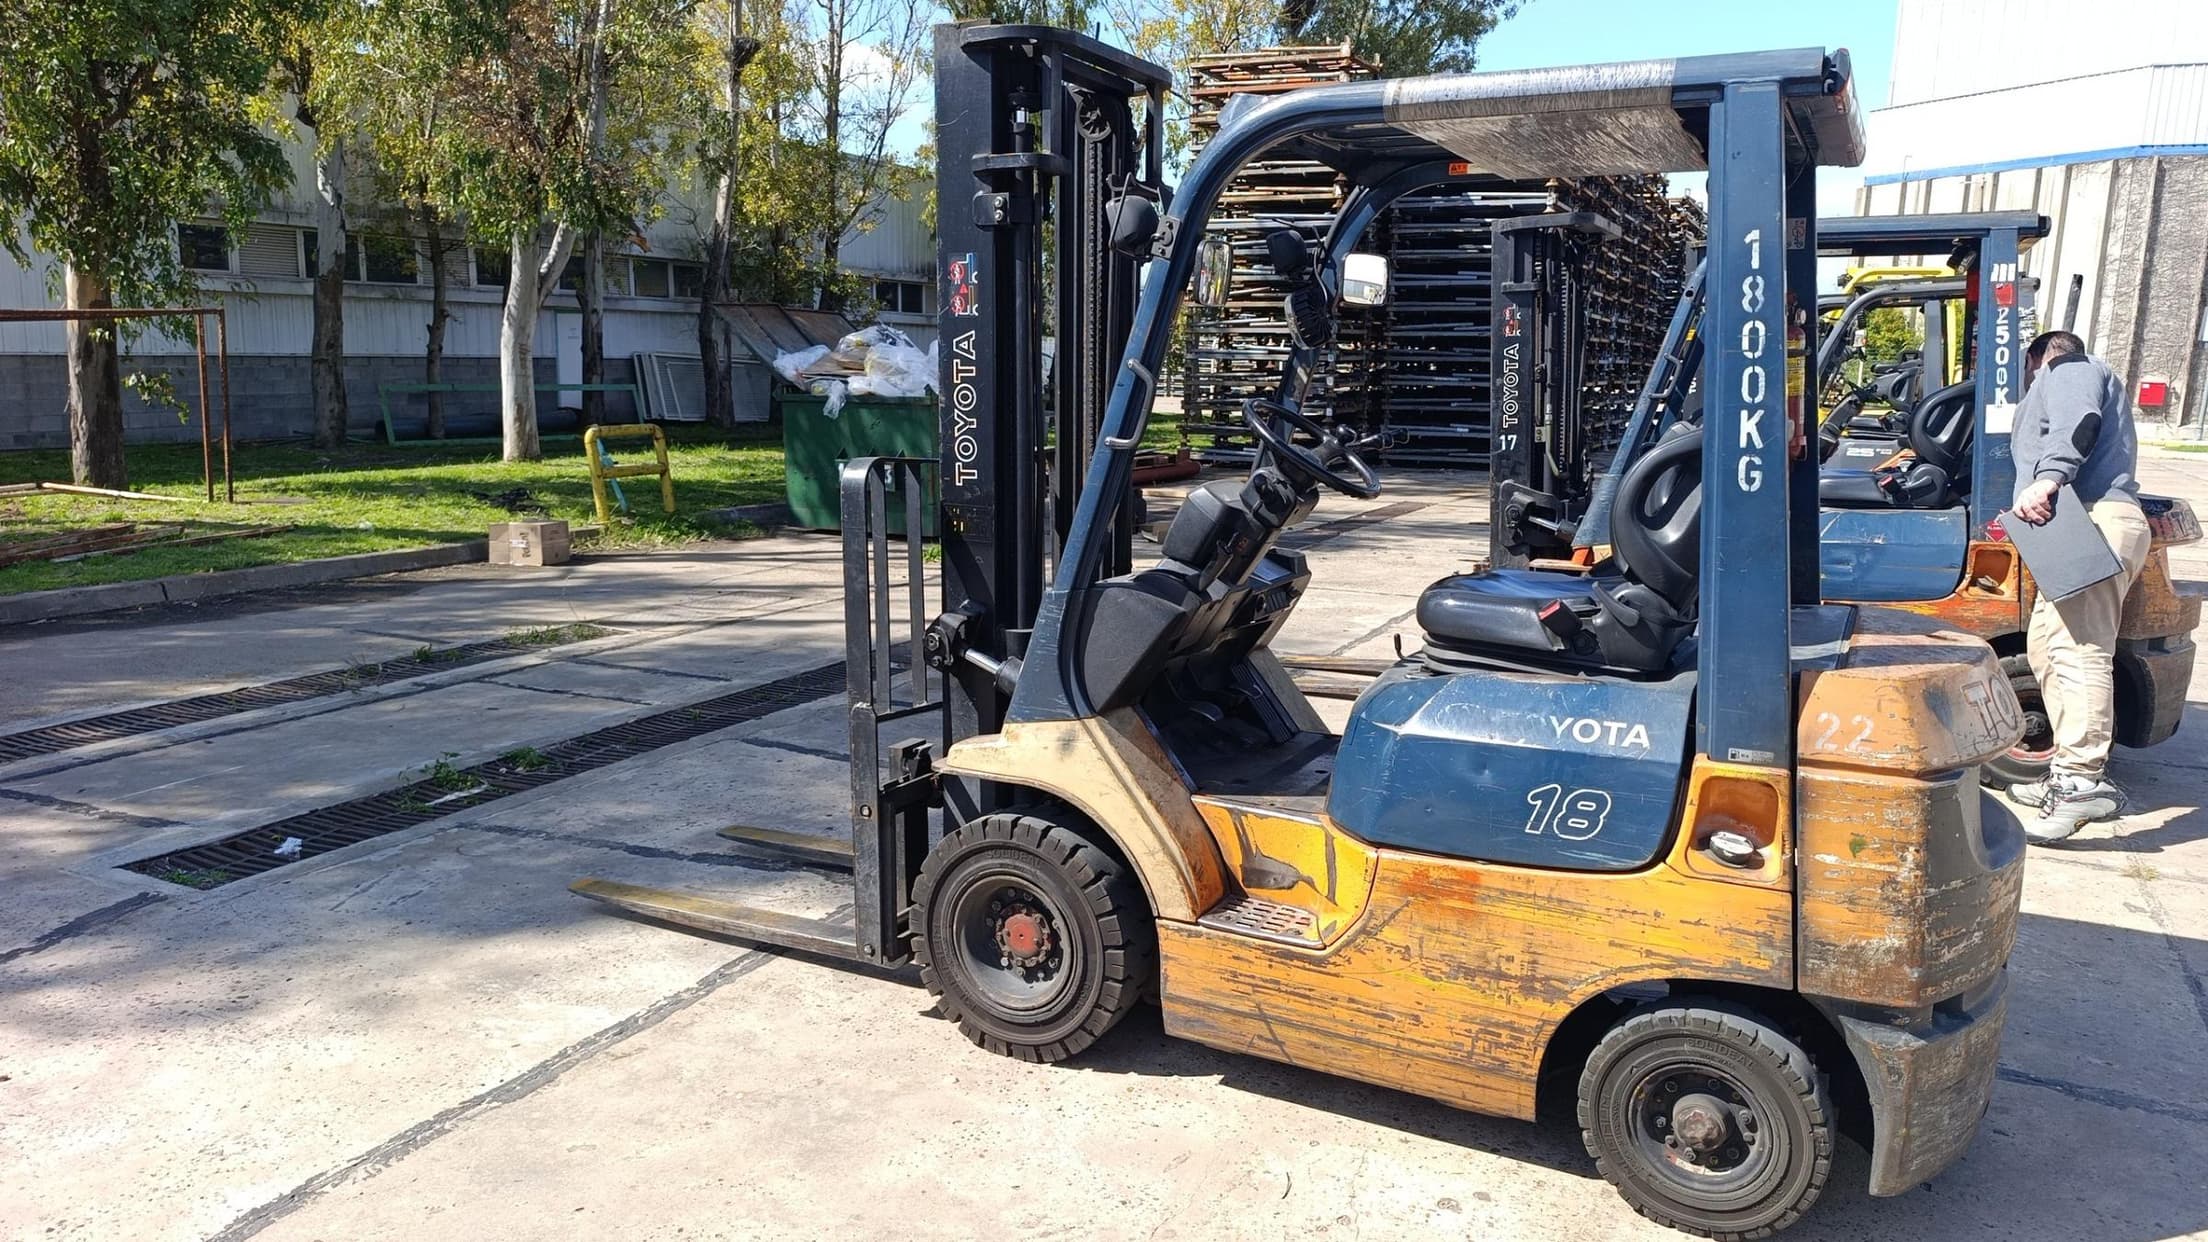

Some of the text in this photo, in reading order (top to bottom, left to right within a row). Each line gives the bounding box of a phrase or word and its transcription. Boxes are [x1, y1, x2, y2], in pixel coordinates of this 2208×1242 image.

[1503, 343, 1519, 428] TOYOTA
[1738, 229, 1767, 493] 1800KG
[953, 330, 978, 486] TOYOTA
[1499, 434, 1518, 451] 17
[1549, 715, 1651, 751] YOTA
[1815, 711, 1875, 752] 22
[1525, 783, 1613, 841] 18
